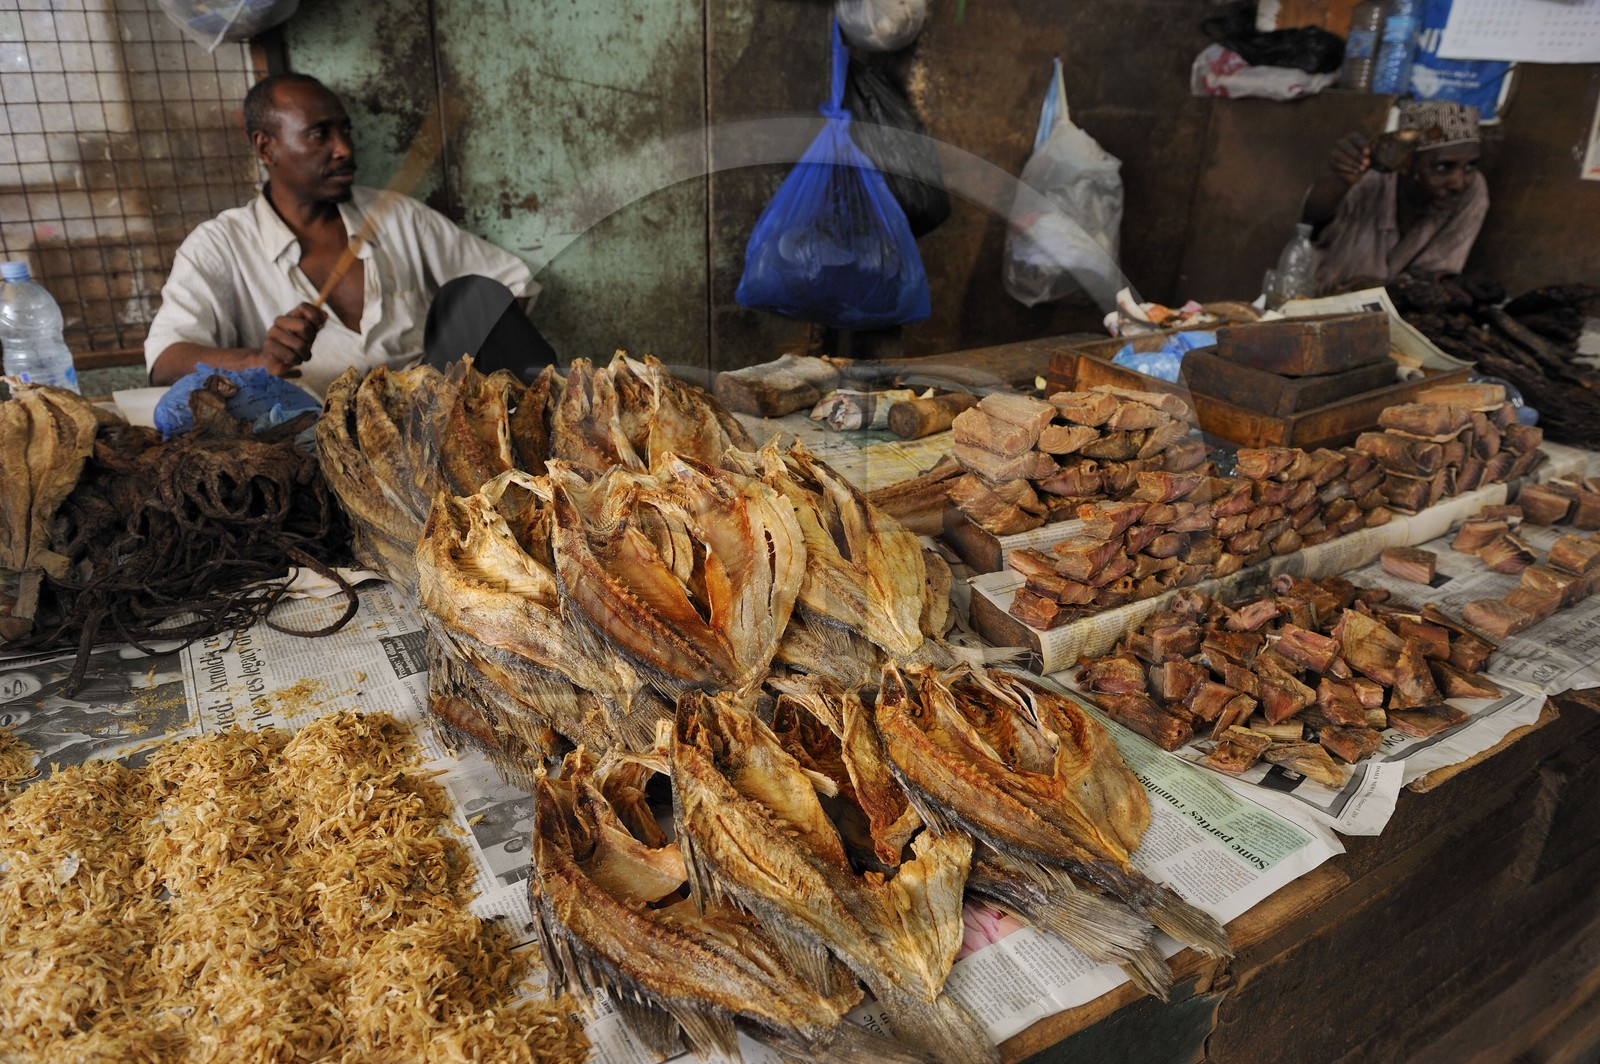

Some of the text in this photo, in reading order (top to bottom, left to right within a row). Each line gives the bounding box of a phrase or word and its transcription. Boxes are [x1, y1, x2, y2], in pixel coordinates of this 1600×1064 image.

[238, 648, 266, 679] legacy
[1139, 775, 1185, 809] running
[1231, 844, 1270, 871] Some
